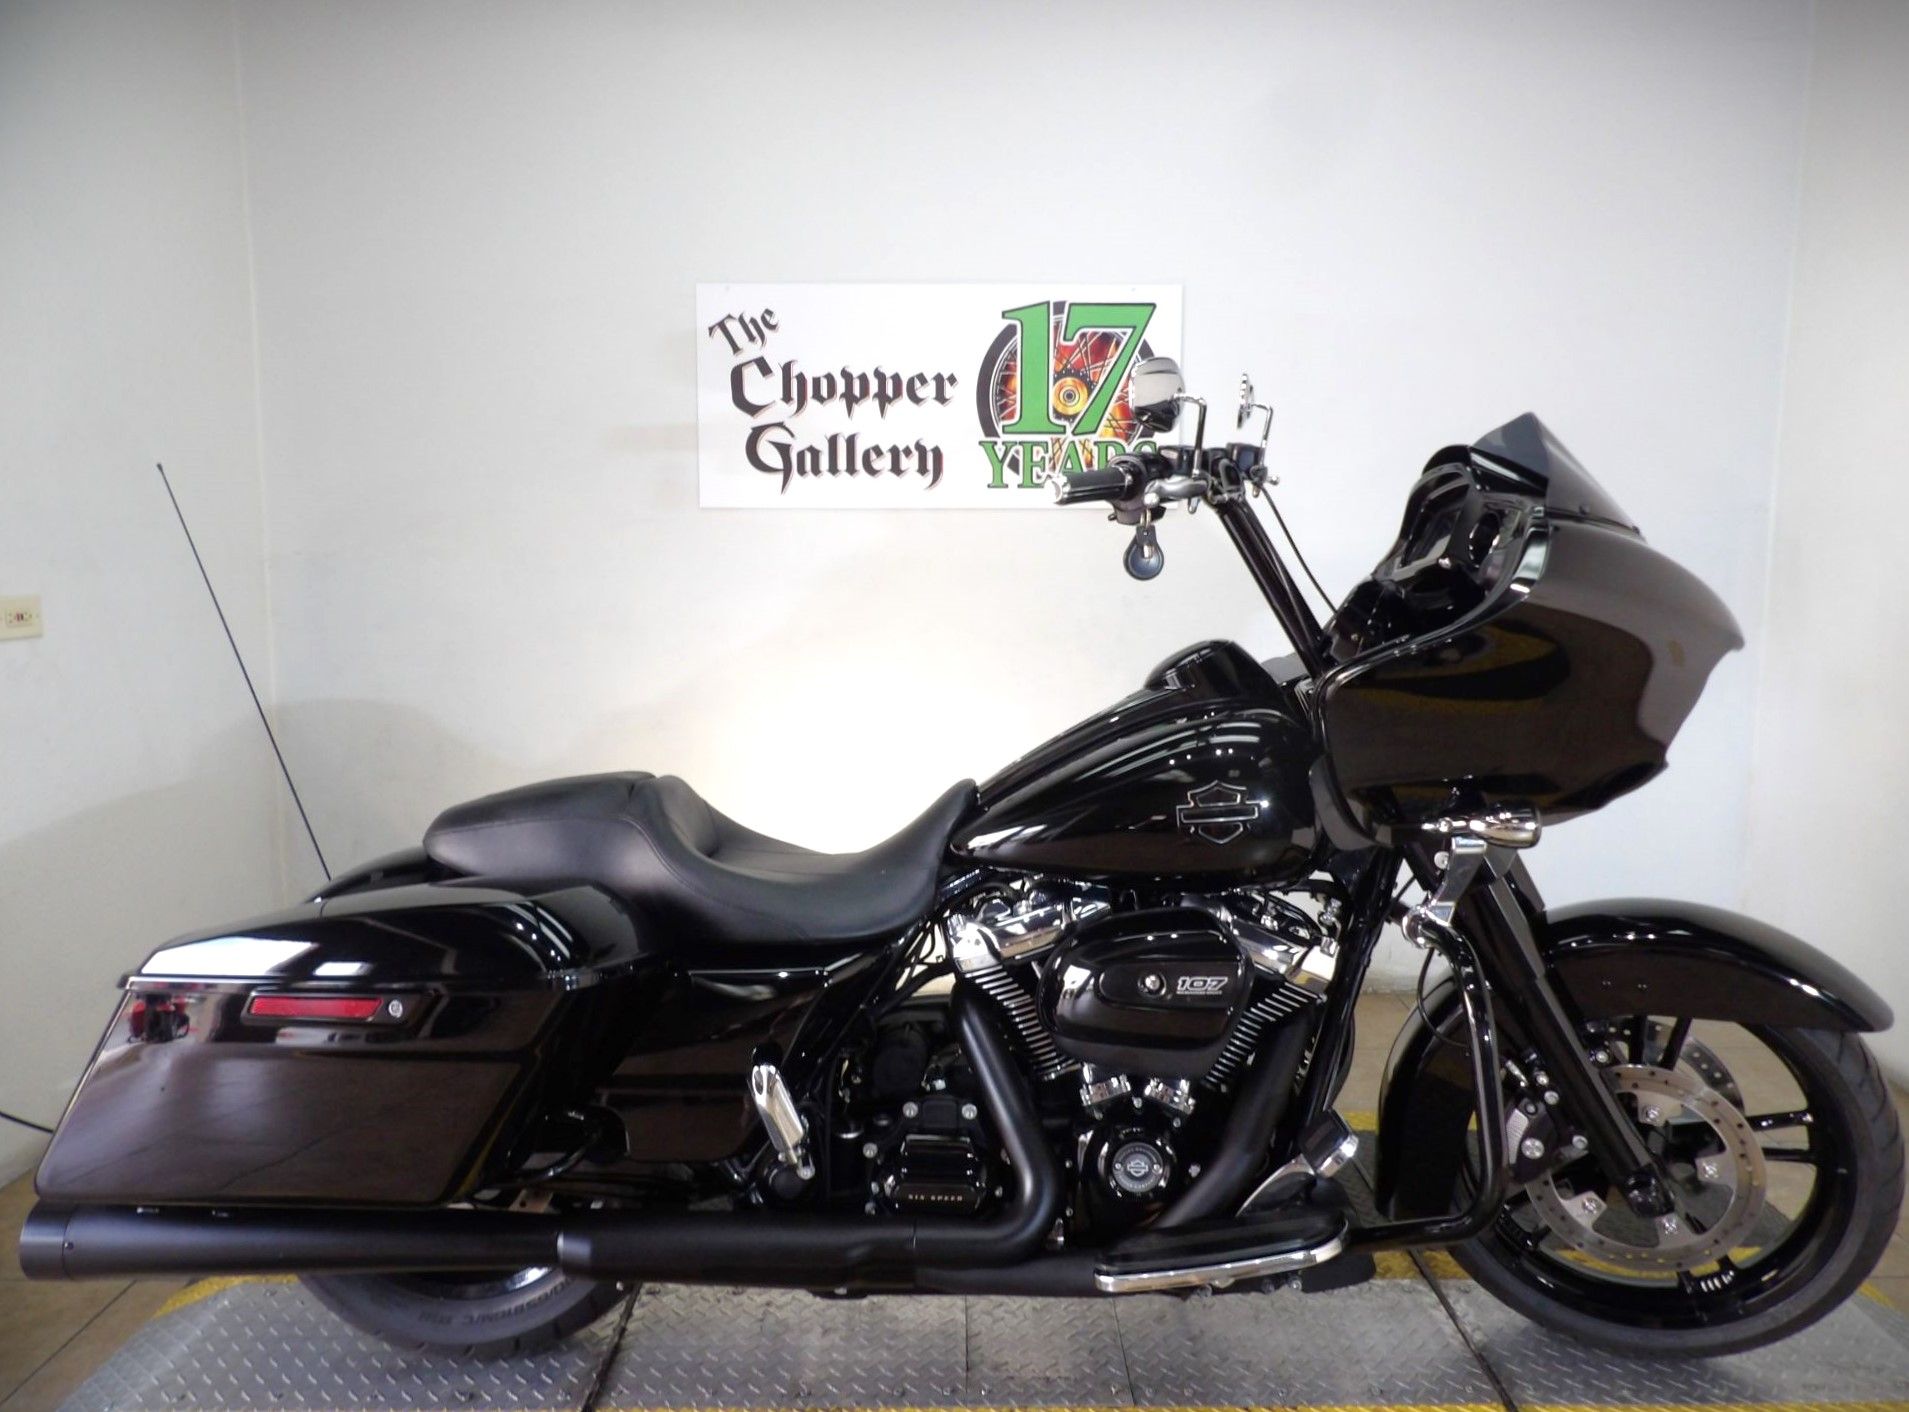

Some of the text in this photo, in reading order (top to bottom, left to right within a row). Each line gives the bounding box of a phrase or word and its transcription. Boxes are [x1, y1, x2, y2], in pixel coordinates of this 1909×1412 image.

[708, 308, 779, 355] The
[731, 356, 958, 419] Chopper
[1001, 300, 1157, 436] 17
[745, 421, 944, 495] Gallery
[1177, 976, 1228, 991] 107
